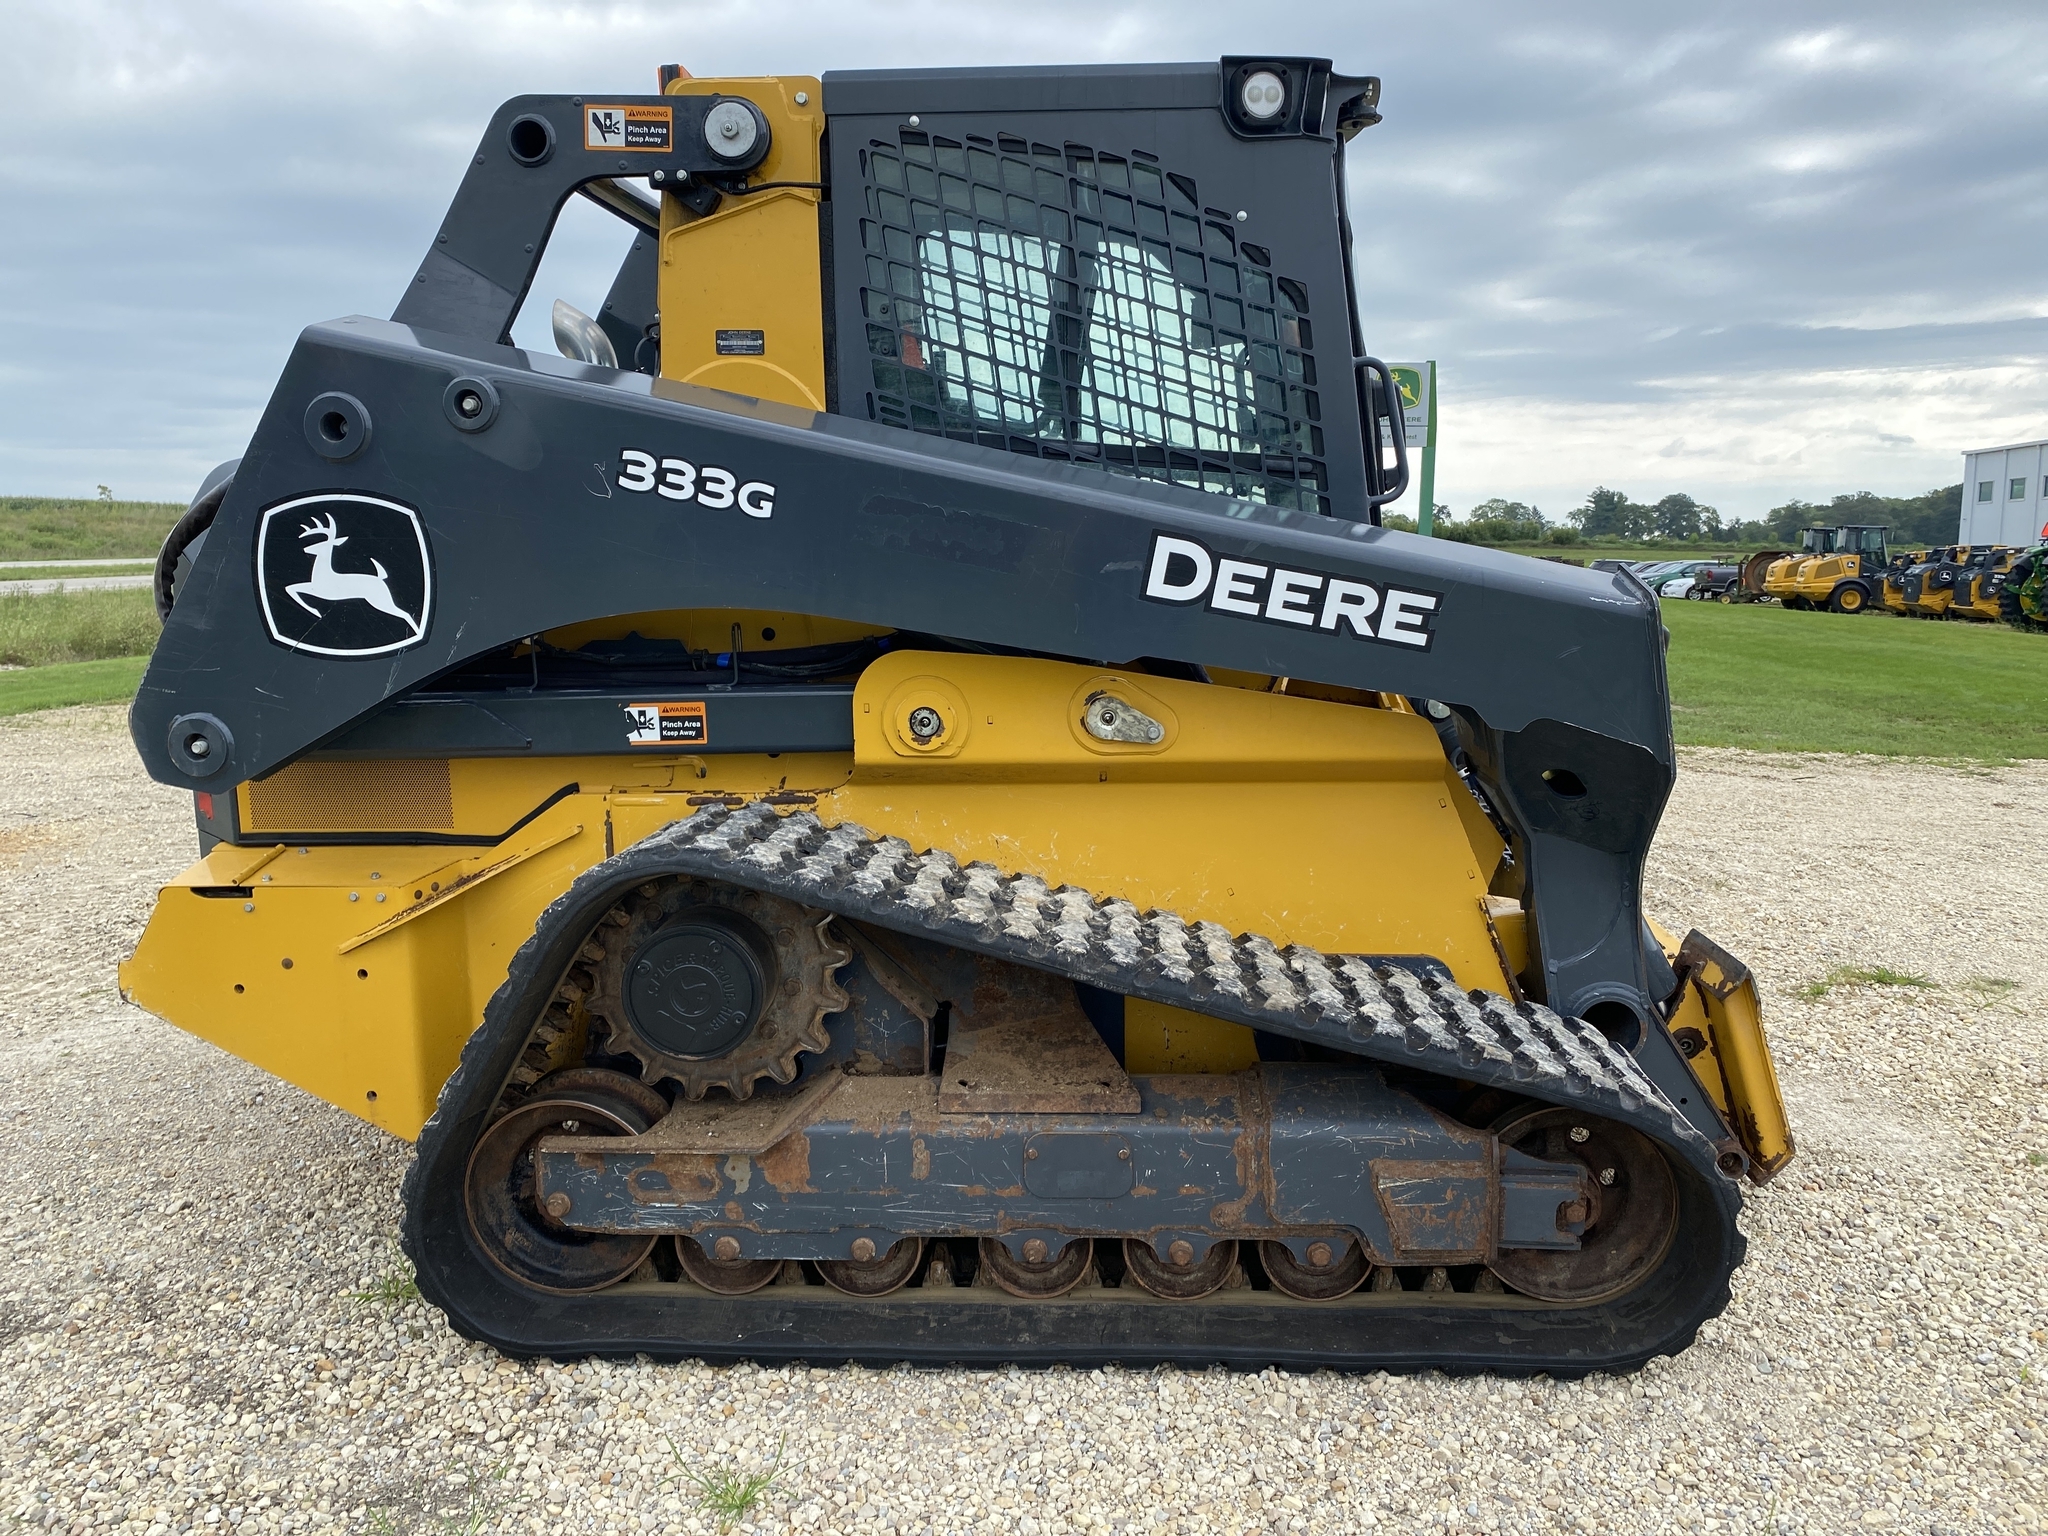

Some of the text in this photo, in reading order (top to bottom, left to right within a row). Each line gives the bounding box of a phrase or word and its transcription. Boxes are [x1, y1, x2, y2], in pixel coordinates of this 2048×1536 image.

[636, 110, 668, 118] WARNING
[627, 126, 667, 134] Pinch Area
[627, 135, 662, 144] Keep Away
[618, 450, 775, 519] 333G
[1145, 535, 1437, 646] DEERE
[683, 720, 701, 728] Area
